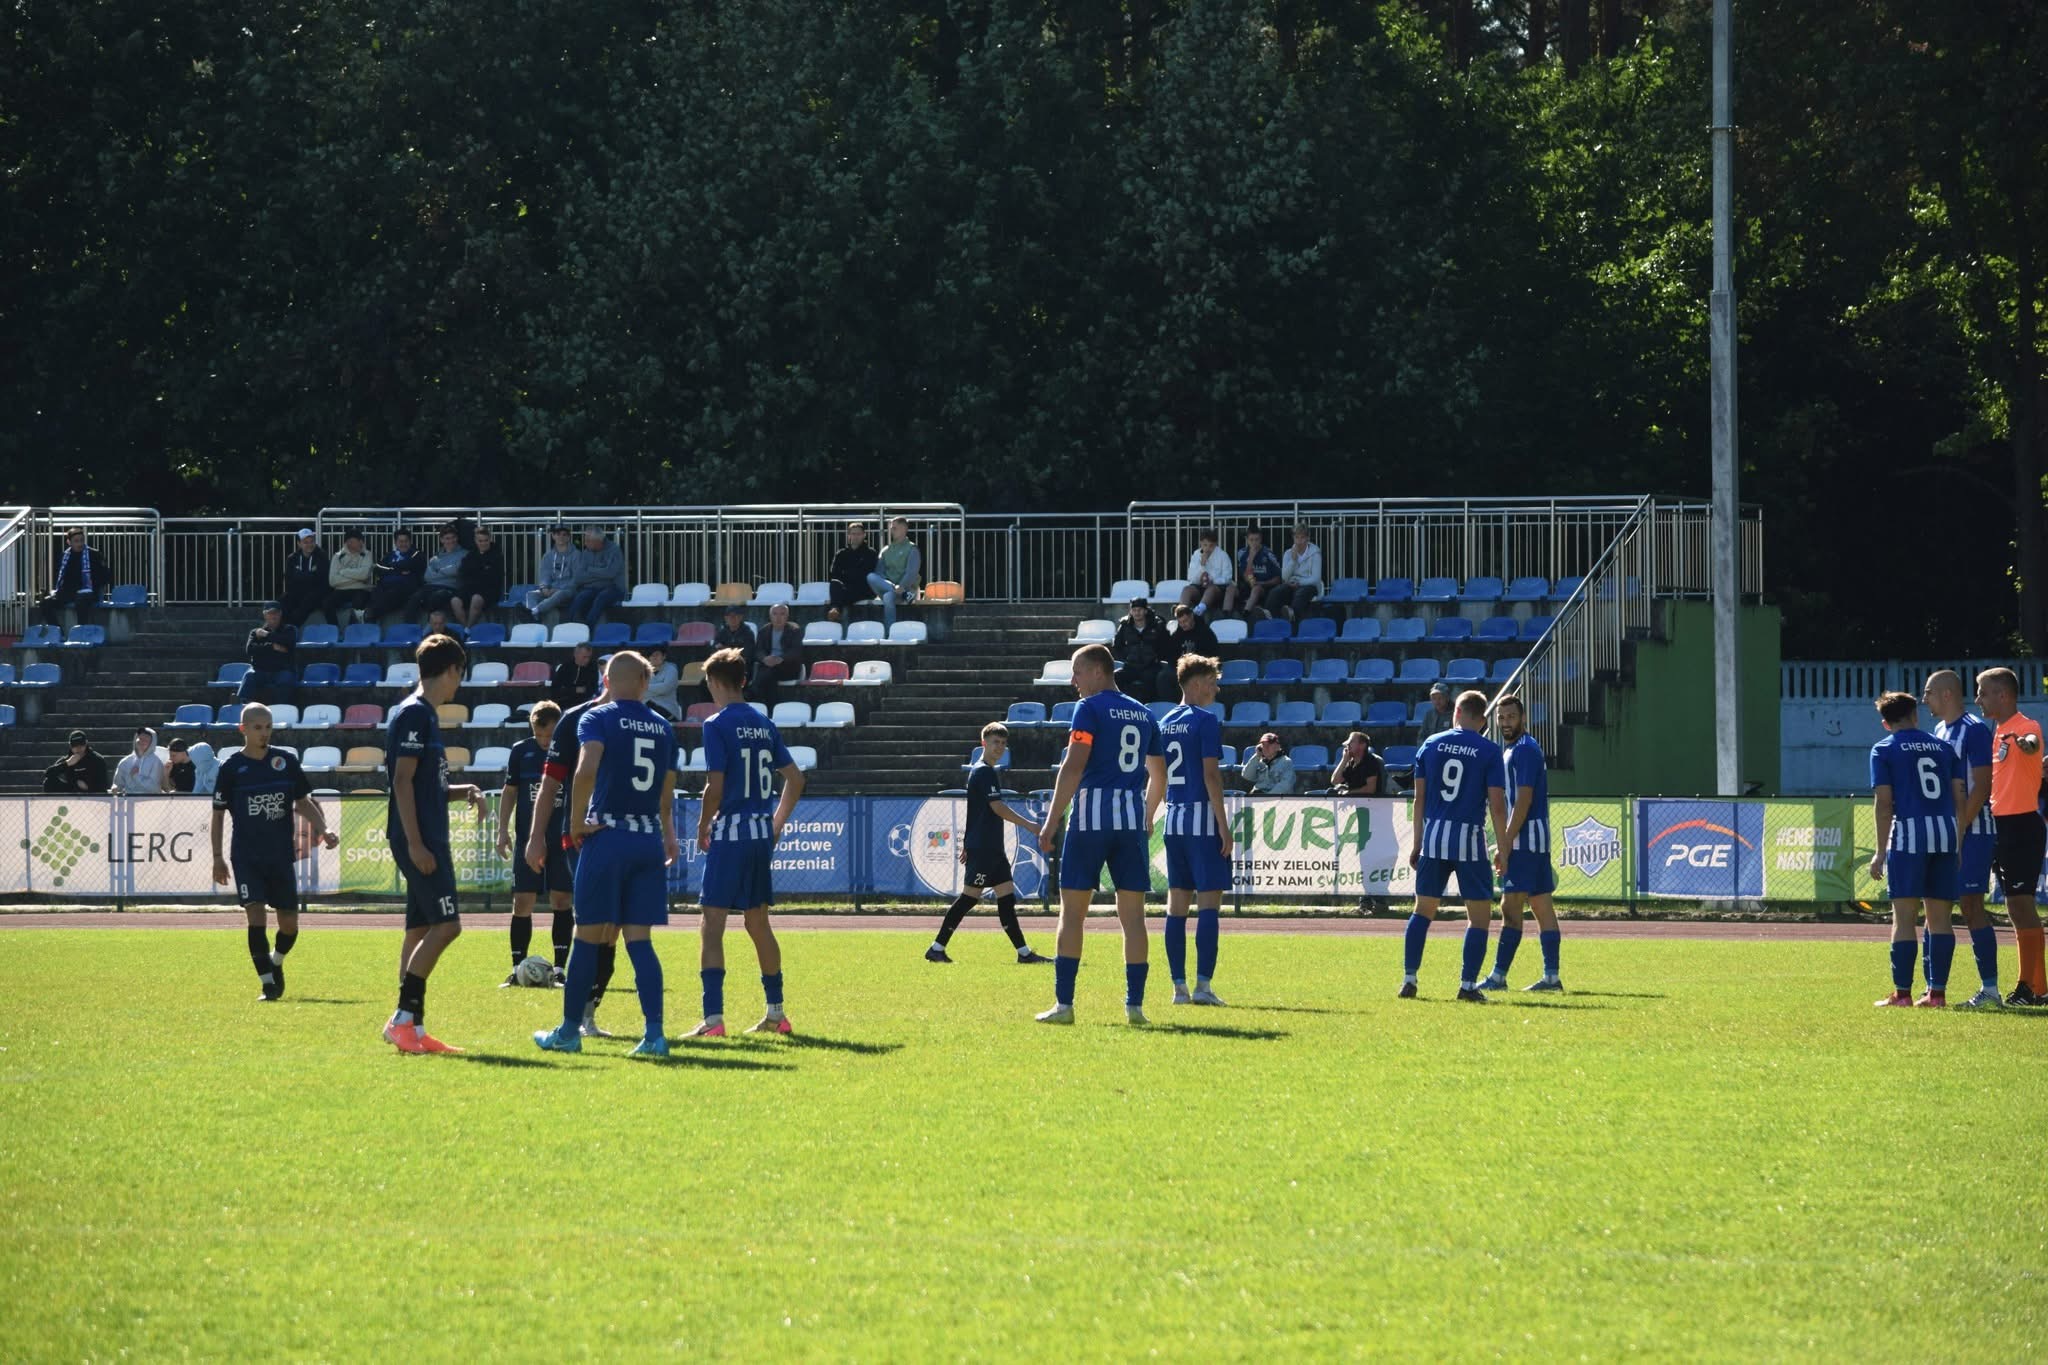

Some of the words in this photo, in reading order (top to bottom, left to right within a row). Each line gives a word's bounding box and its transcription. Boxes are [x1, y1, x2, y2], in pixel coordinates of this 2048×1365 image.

[1109, 708, 1149, 722] CHEMIK
[619, 717, 667, 735] CHEMIK
[736, 727, 772, 739] CHEMIK
[1118, 724, 1141, 773] 8
[1437, 742, 1479, 757] CHEMIK
[1900, 742, 1943, 751] CHEMIK
[631, 737, 656, 792] 5
[1166, 741, 1186, 785] 2
[740, 748, 774, 800] 16
[1440, 759, 1464, 802] 9
[1917, 757, 1941, 799] 6
[780, 820, 844, 835] pieramy
[107, 832, 194, 862] LERG
[345, 848, 394, 862] SPOR
[1559, 840, 1621, 868] JUNIOR
[1665, 844, 1733, 867] PGE
[1283, 860, 1340, 871] ZIELONE
[974, 873, 986, 886] 25
[1232, 875, 1262, 886] GNIJ
[1266, 876, 1275, 885] Z
[1278, 876, 1313, 886] NAMI
[1317, 873, 1364, 888] SWOJE
[240, 884, 249, 899] 9
[439, 896, 455, 916] 15
